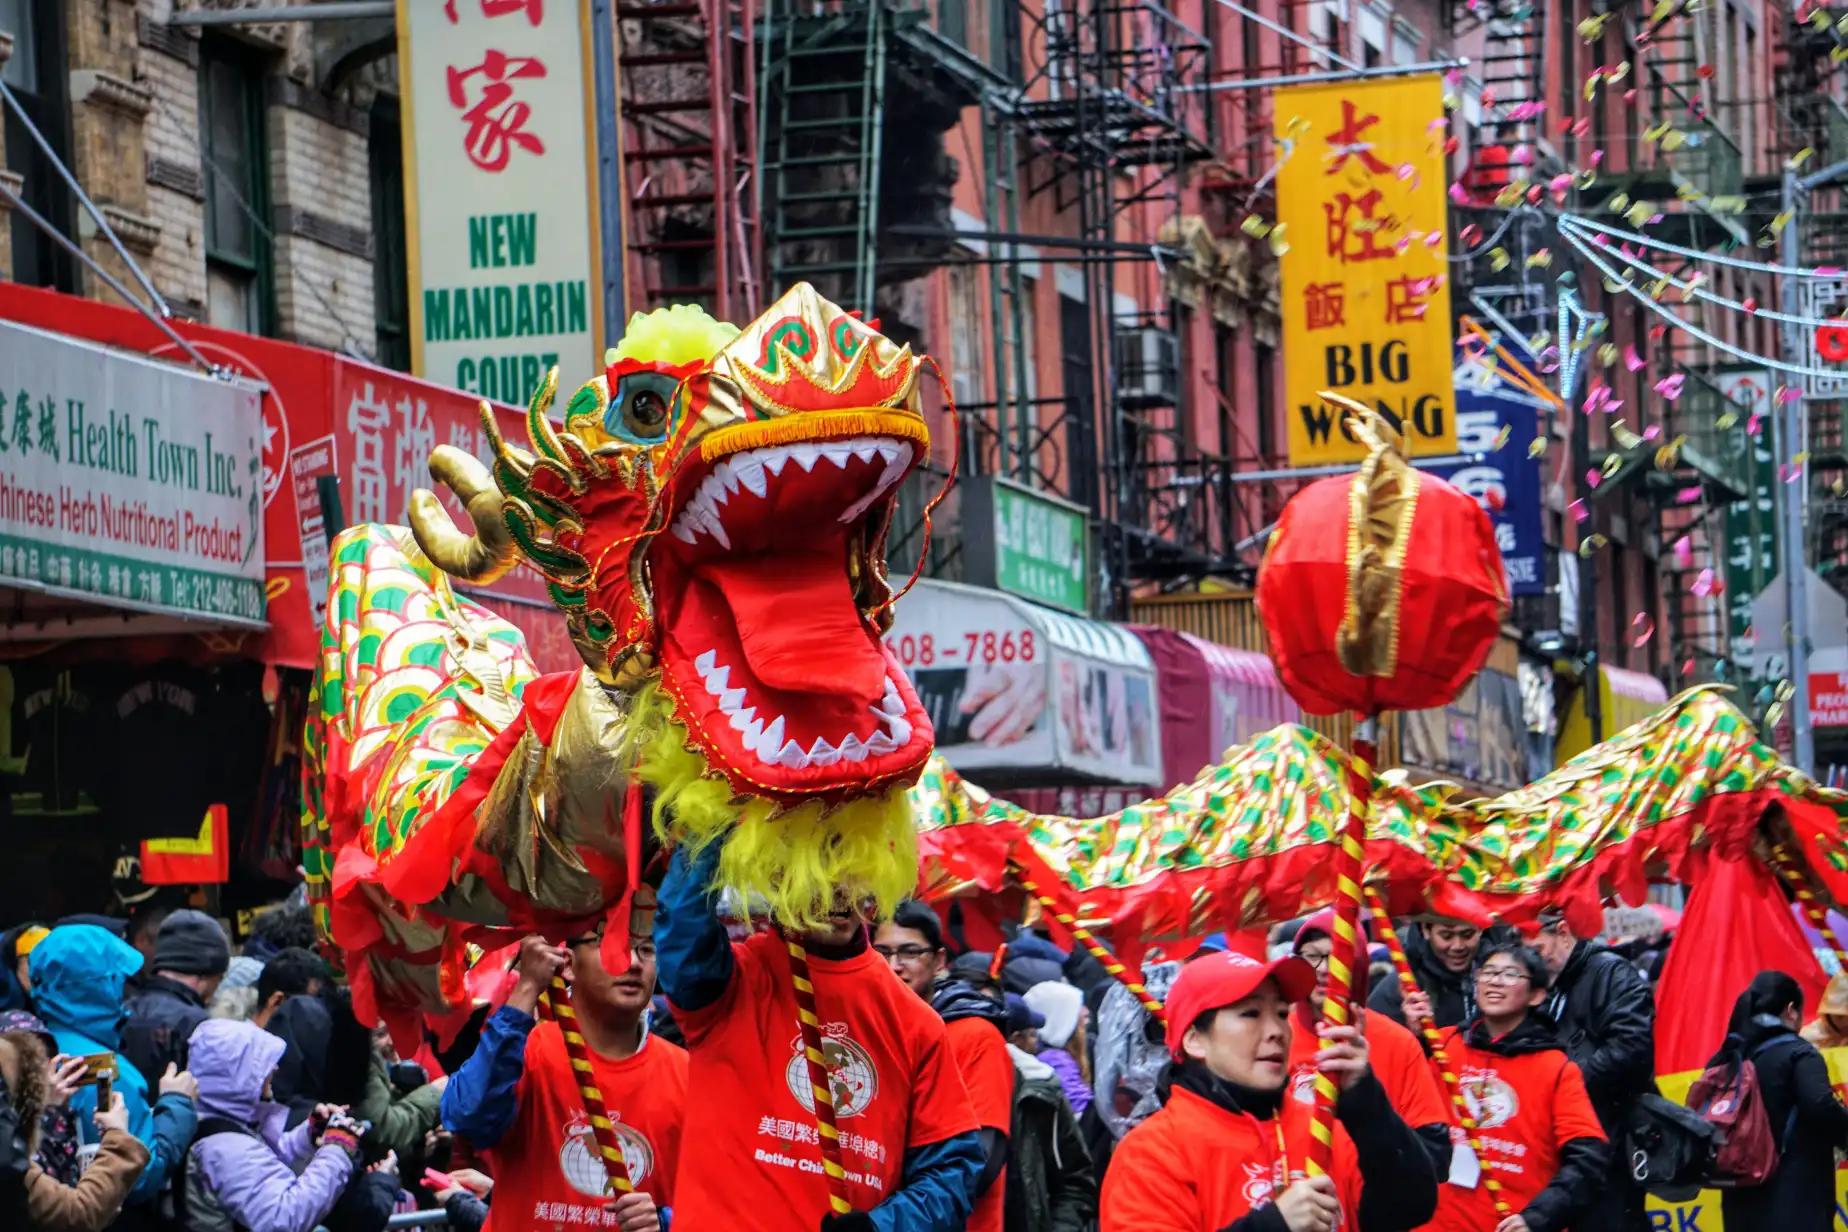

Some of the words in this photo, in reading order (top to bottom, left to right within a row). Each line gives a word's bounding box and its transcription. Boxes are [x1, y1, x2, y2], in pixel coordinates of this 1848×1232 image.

[444, 0, 549, 172] 家
[468, 212, 537, 269] NEW
[424, 280, 588, 342] MANDARIN
[1303, 273, 1429, 332] 飯店
[1325, 340, 1411, 387] BIG
[66, 398, 138, 478] Health
[143, 416, 199, 491] Town
[205, 432, 242, 498] Inc.
[0, 471, 55, 528] hinese
[60, 484, 98, 537] Herb
[101, 493, 180, 552] Nutritional
[184, 510, 242, 564] Product
[755, 1148, 797, 1169] Better
